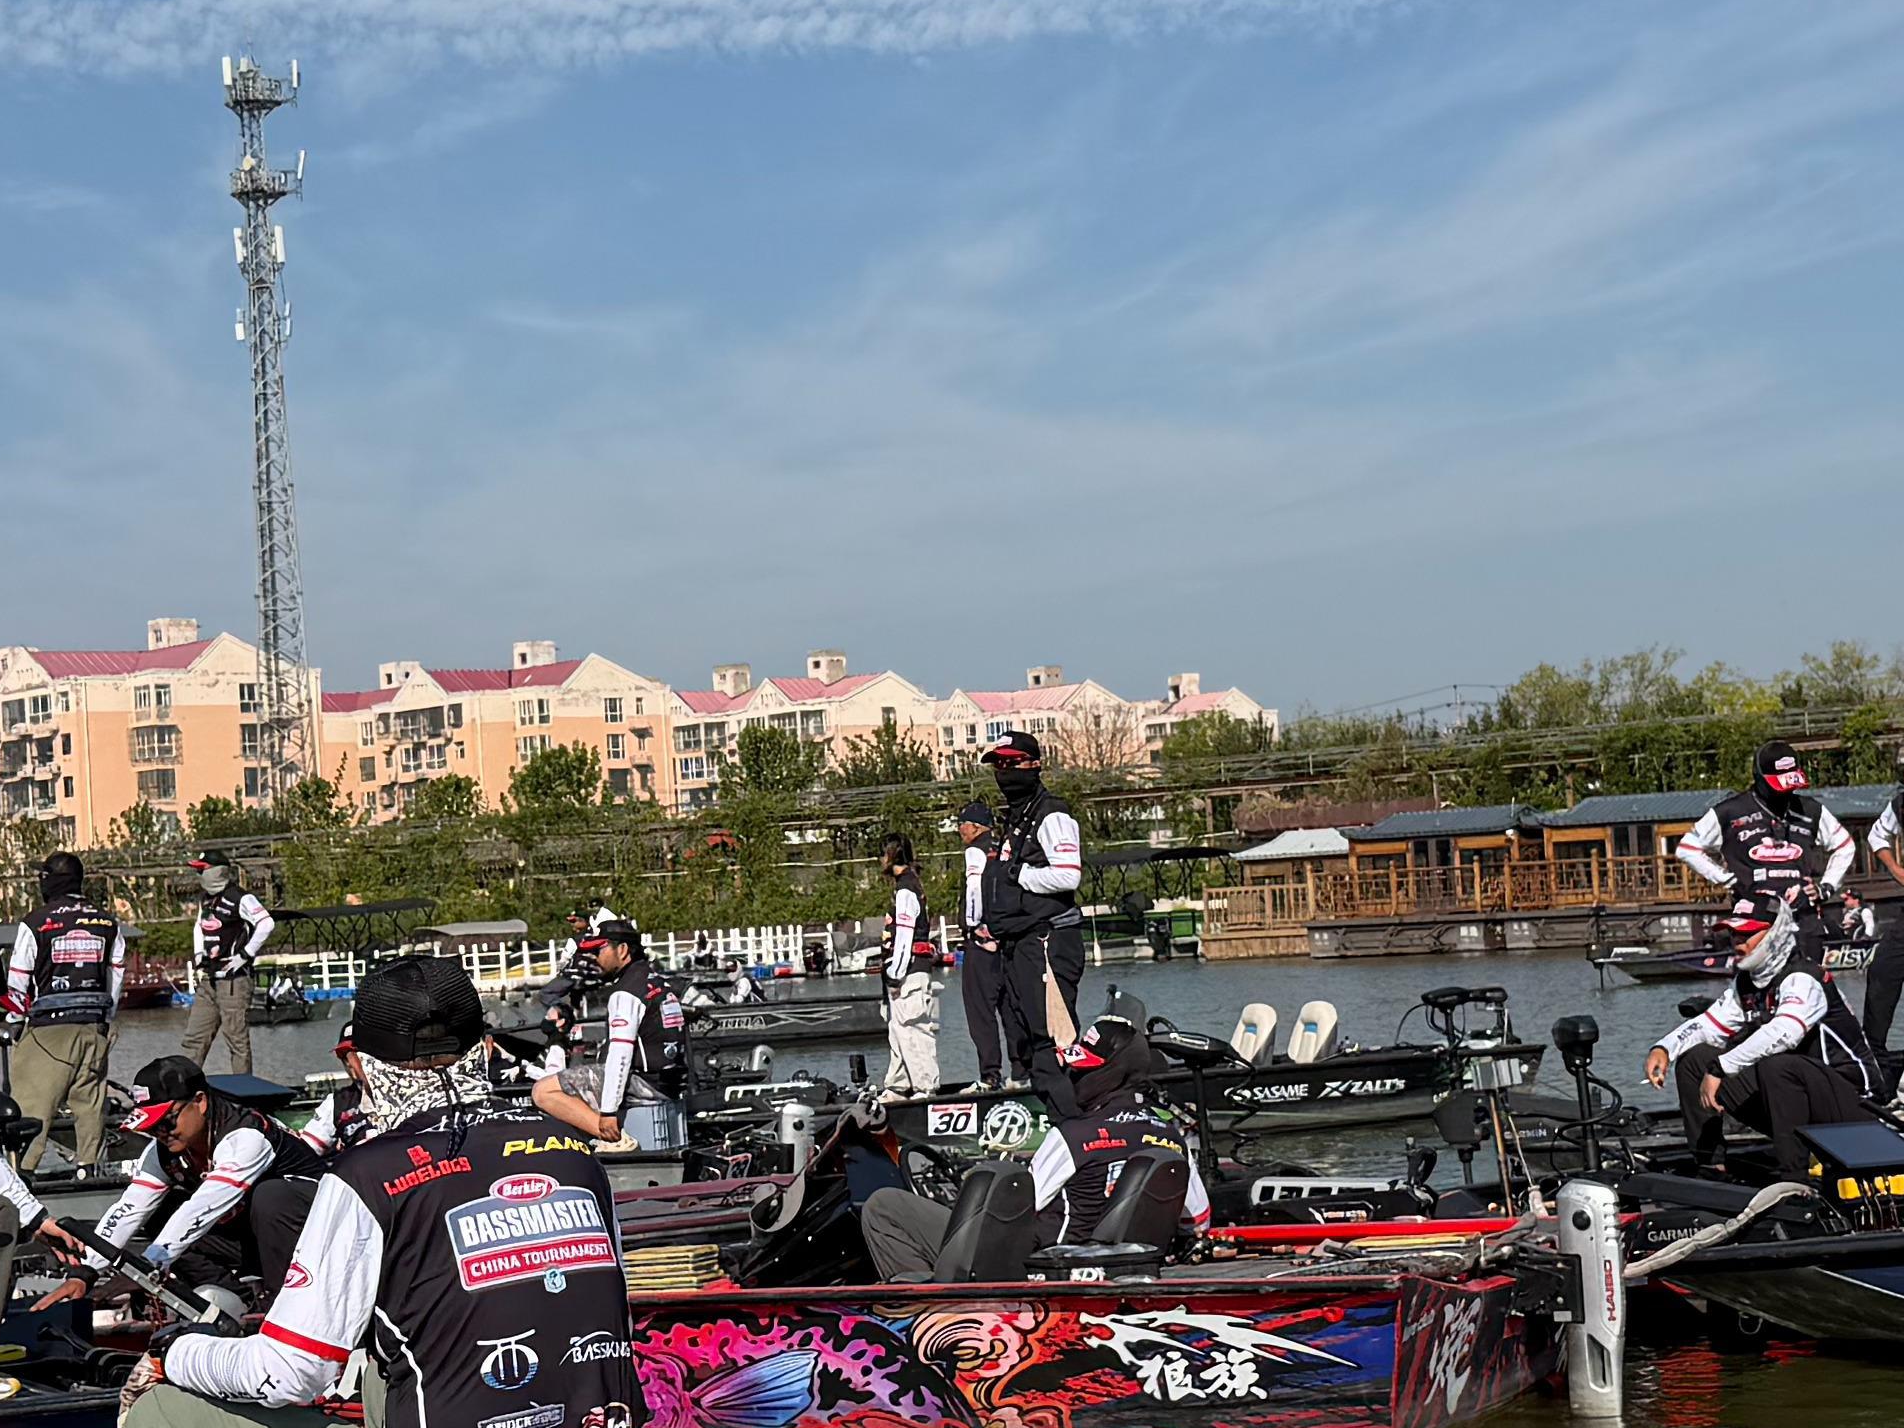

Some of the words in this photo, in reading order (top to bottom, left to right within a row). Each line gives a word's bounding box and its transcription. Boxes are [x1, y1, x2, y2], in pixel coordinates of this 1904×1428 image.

[1253, 1083, 1309, 1100] SASAME
[933, 1111, 972, 1134] 30
[503, 1136, 591, 1157] PLANO
[458, 1199, 602, 1248] BASSMASTER
[470, 1255, 522, 1277] CHINA
[524, 1242, 610, 1266] TOURNAMENT
[1136, 1348, 1269, 1401] 狼族
